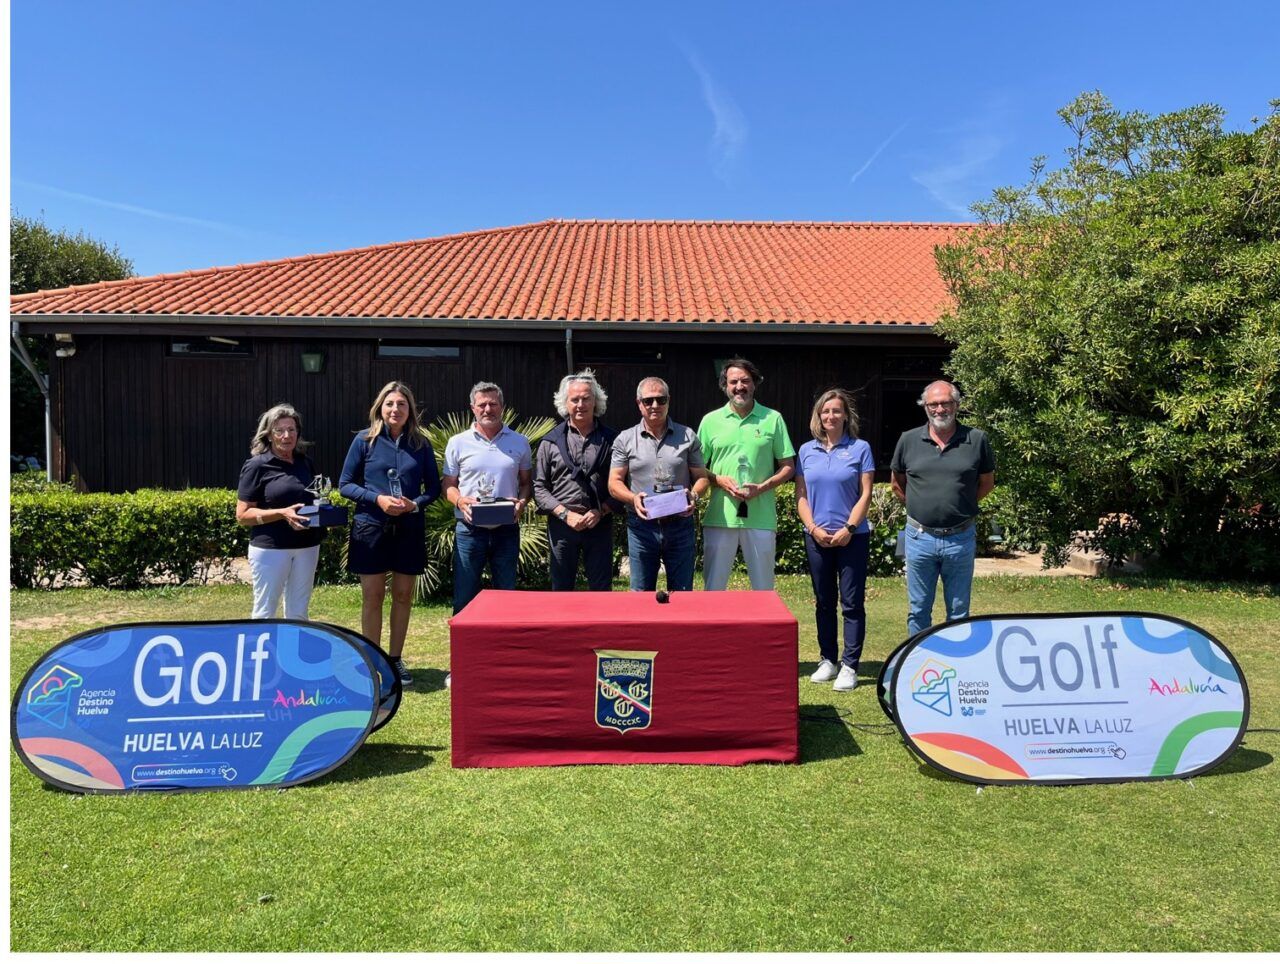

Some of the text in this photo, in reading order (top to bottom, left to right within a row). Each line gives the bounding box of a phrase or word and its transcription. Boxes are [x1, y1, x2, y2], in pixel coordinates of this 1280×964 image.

[995, 624, 1120, 694] Golf
[132, 632, 271, 708] Golf
[958, 680, 989, 690] Agencia
[1148, 676, 1228, 697] Andalucía
[80, 688, 116, 699] Agencia
[958, 688, 990, 696] Destino
[78, 697, 114, 707] Destino
[959, 696, 987, 704] Huelva
[77, 706, 109, 715] Huelva
[1004, 718, 1081, 736] HUELVA
[123, 731, 205, 752] HUELVA
[1029, 746, 1106, 755] www.destinohuelva.org
[136, 767, 217, 777] www.destinohuelva.org
